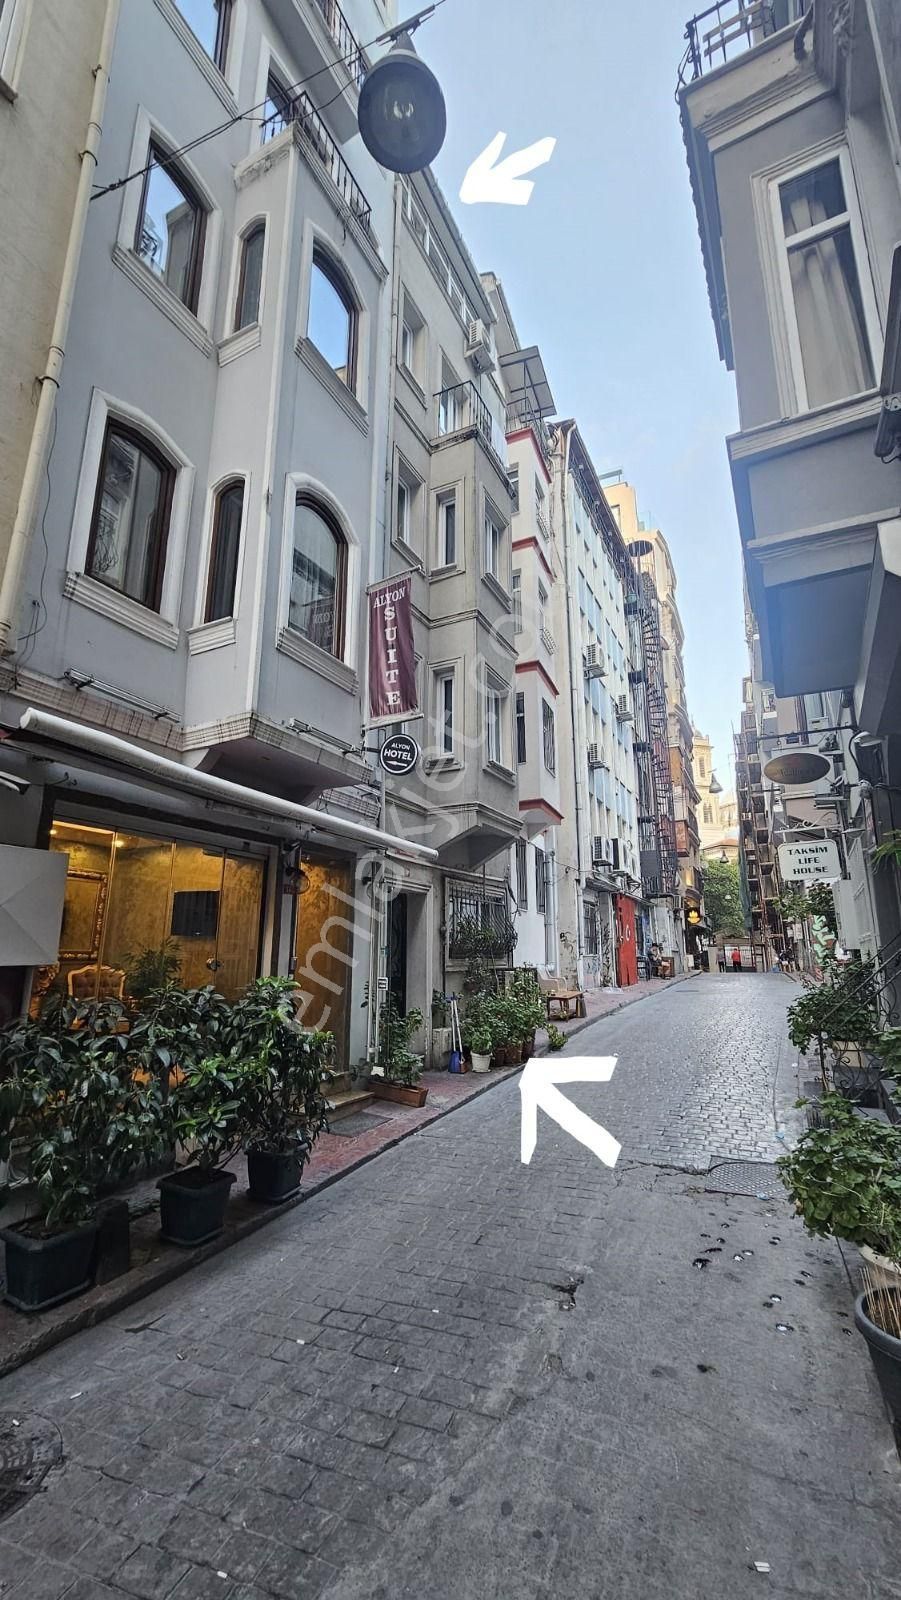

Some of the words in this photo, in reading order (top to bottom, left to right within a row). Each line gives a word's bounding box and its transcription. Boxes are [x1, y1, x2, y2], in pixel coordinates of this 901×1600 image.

[373, 588, 406, 608] ALYON
[384, 607, 401, 705] SUITE
[391, 742, 411, 750] ALYON
[383, 748, 413, 761] HOTEL
[793, 866, 829, 875] HOUSE
